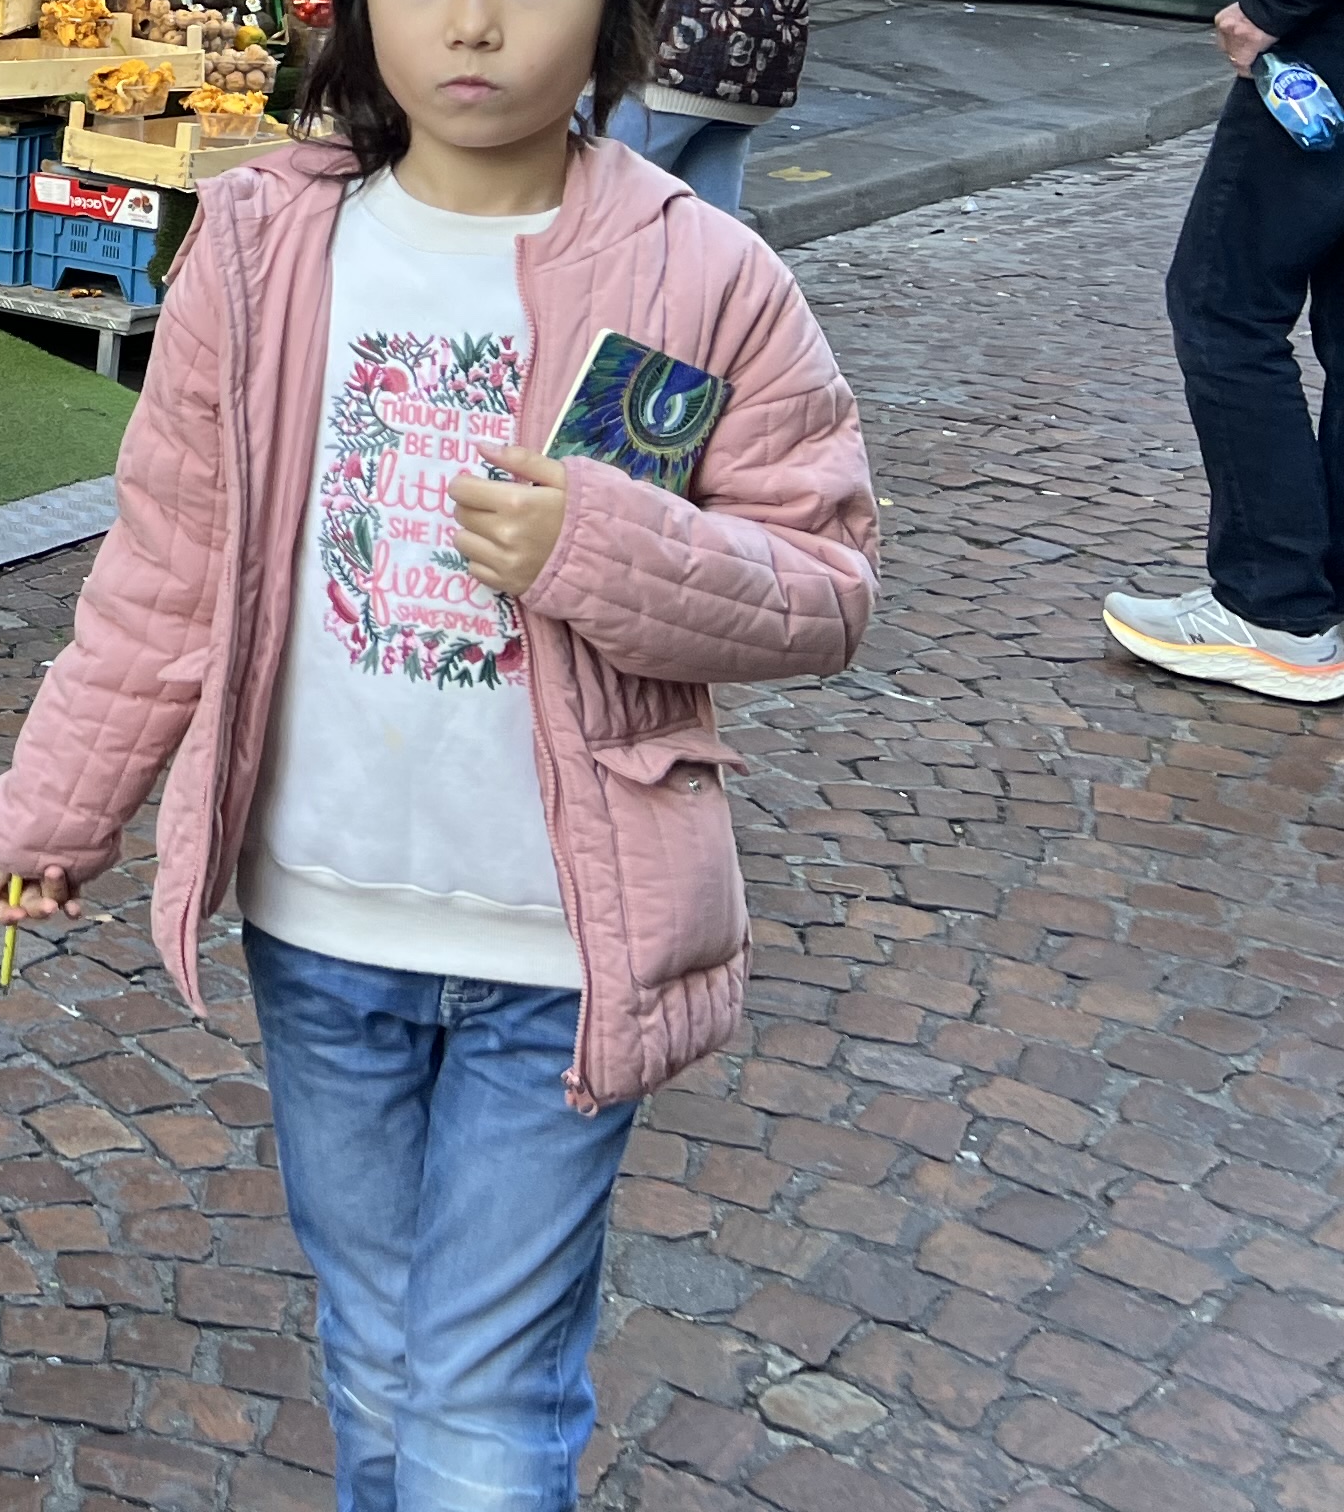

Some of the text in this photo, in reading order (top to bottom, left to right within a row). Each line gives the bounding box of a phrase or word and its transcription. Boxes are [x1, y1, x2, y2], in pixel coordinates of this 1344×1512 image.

[380, 399, 512, 441] THOUGH SHE
[404, 431, 433, 458] BE
[388, 517, 431, 543] SHE
[394, 603, 500, 636] SHAKESPEARE
